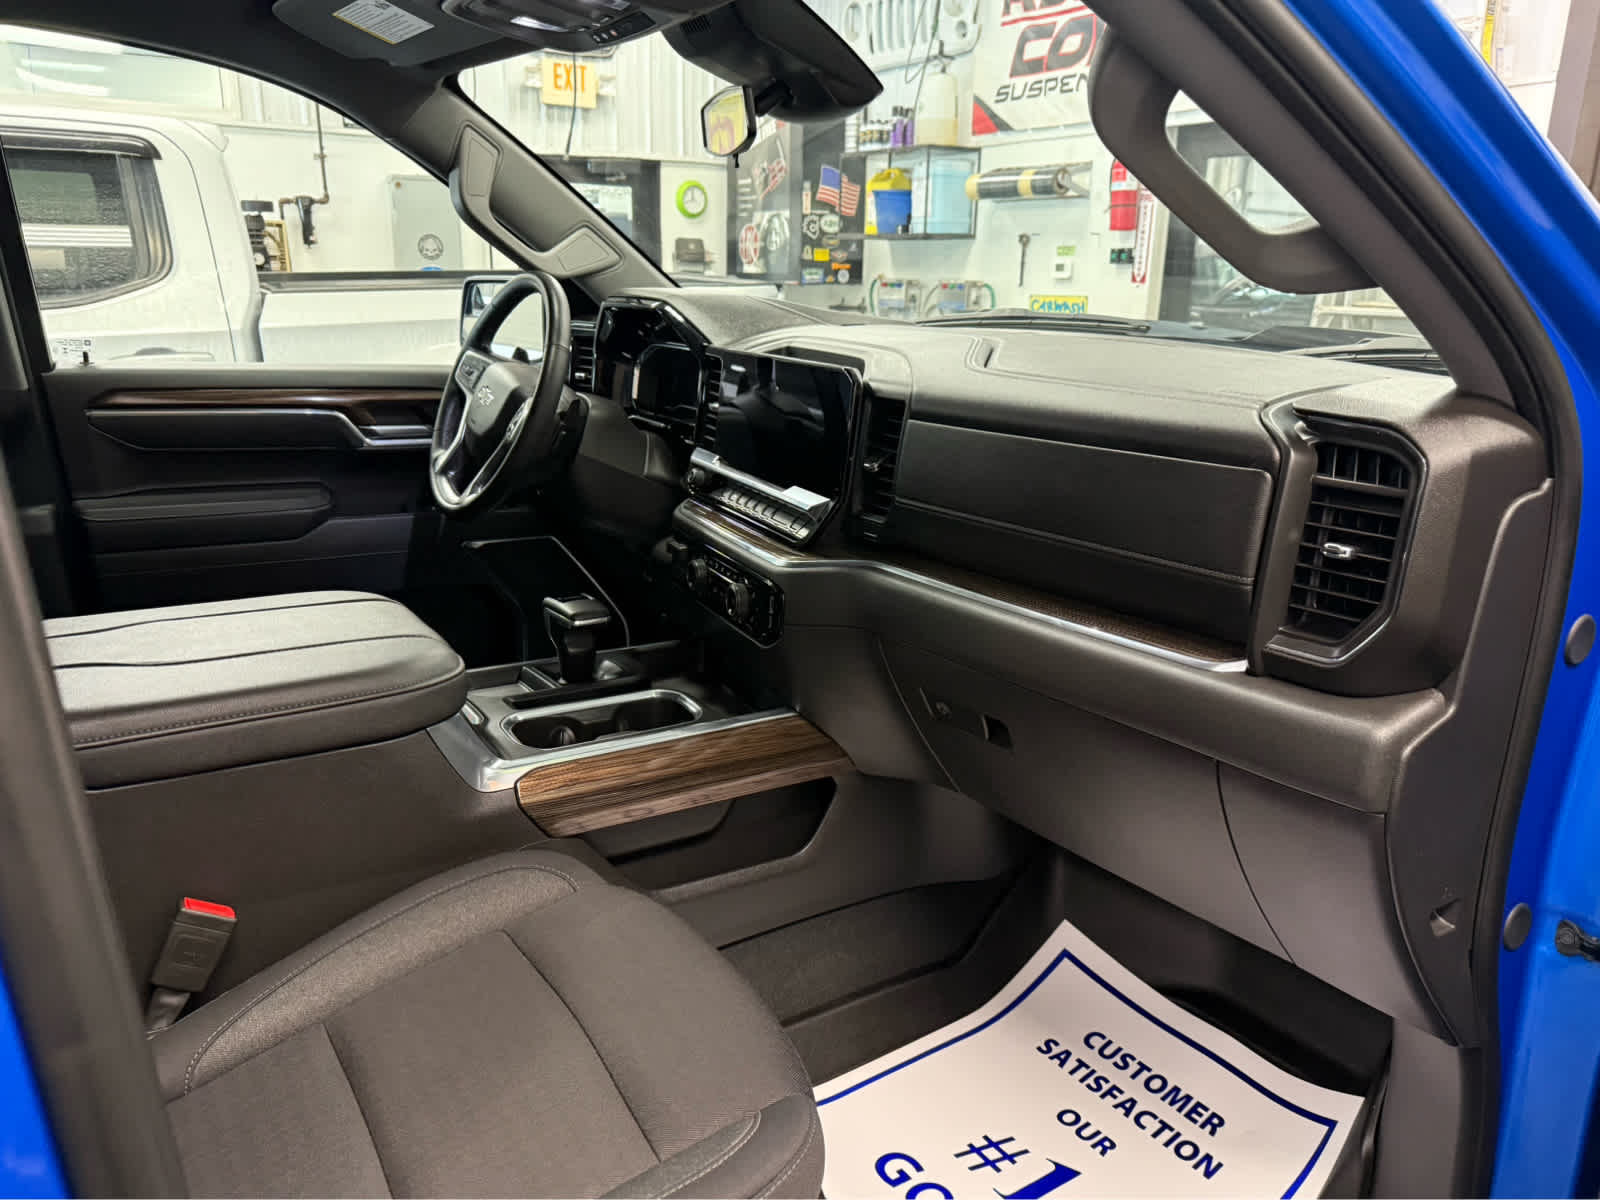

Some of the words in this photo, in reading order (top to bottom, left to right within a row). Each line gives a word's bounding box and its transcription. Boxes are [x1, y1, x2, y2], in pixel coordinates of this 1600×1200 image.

[553, 62, 587, 94] EXT
[1009, 13, 1106, 78] CO
[1036, 1038, 1224, 1180] SATISFACTION
[1083, 1031, 1225, 1137] CUSTOMER
[1056, 1108, 1117, 1157] OUR
[953, 1134, 1082, 1200] #1
